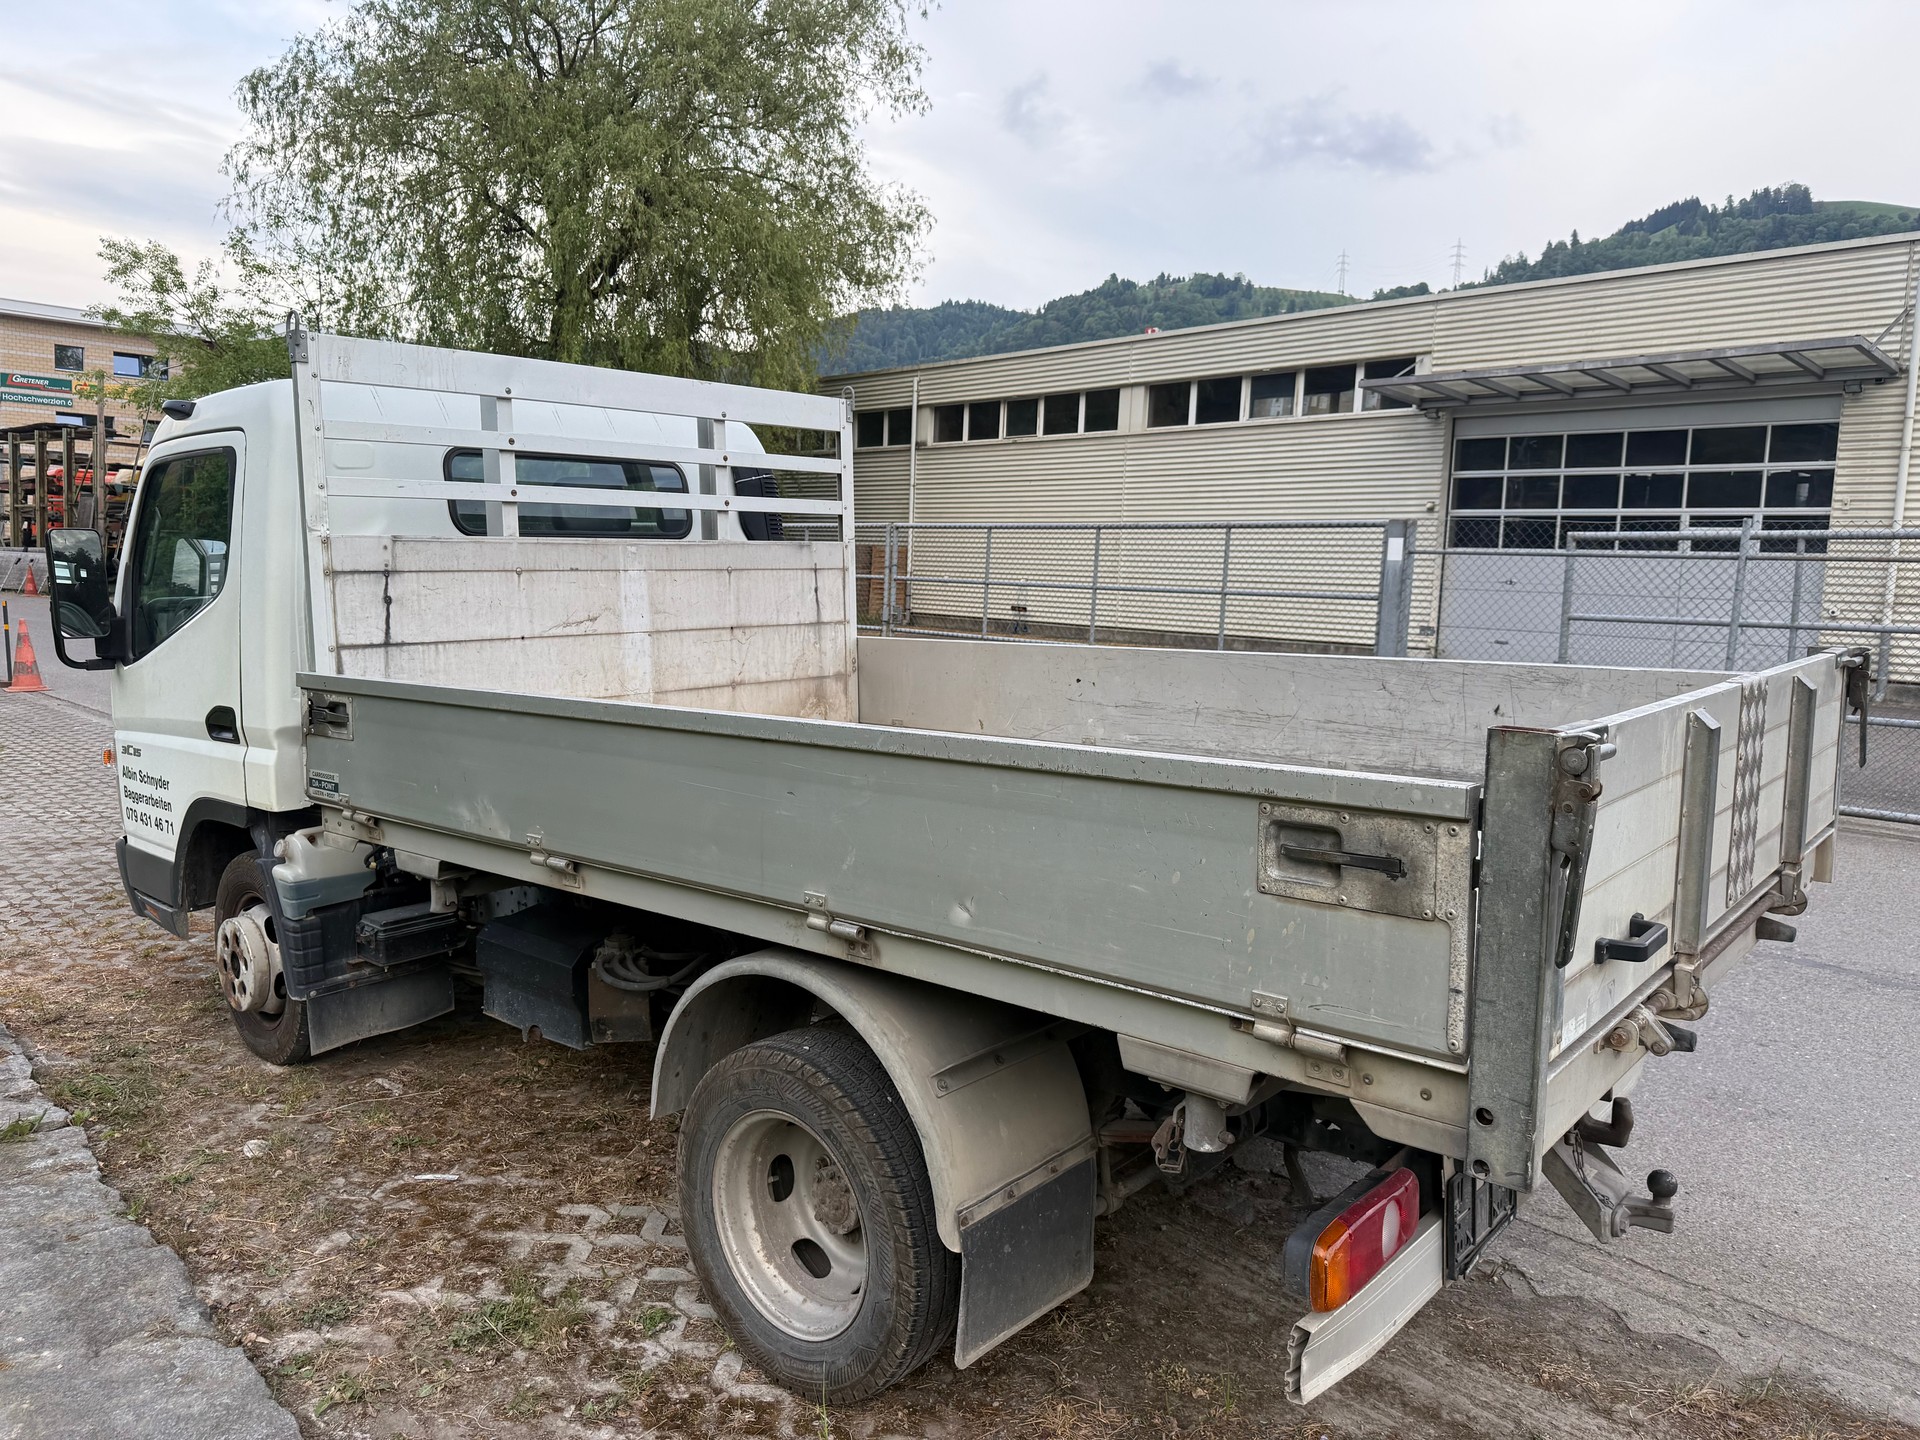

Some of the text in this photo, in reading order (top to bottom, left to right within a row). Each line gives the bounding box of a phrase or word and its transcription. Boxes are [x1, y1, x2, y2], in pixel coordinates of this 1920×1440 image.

[122, 765, 170, 791] Albin Schnyder
[123, 785, 173, 812] Baggerarbeiten
[125, 806, 175, 836] 079 431 46 71
